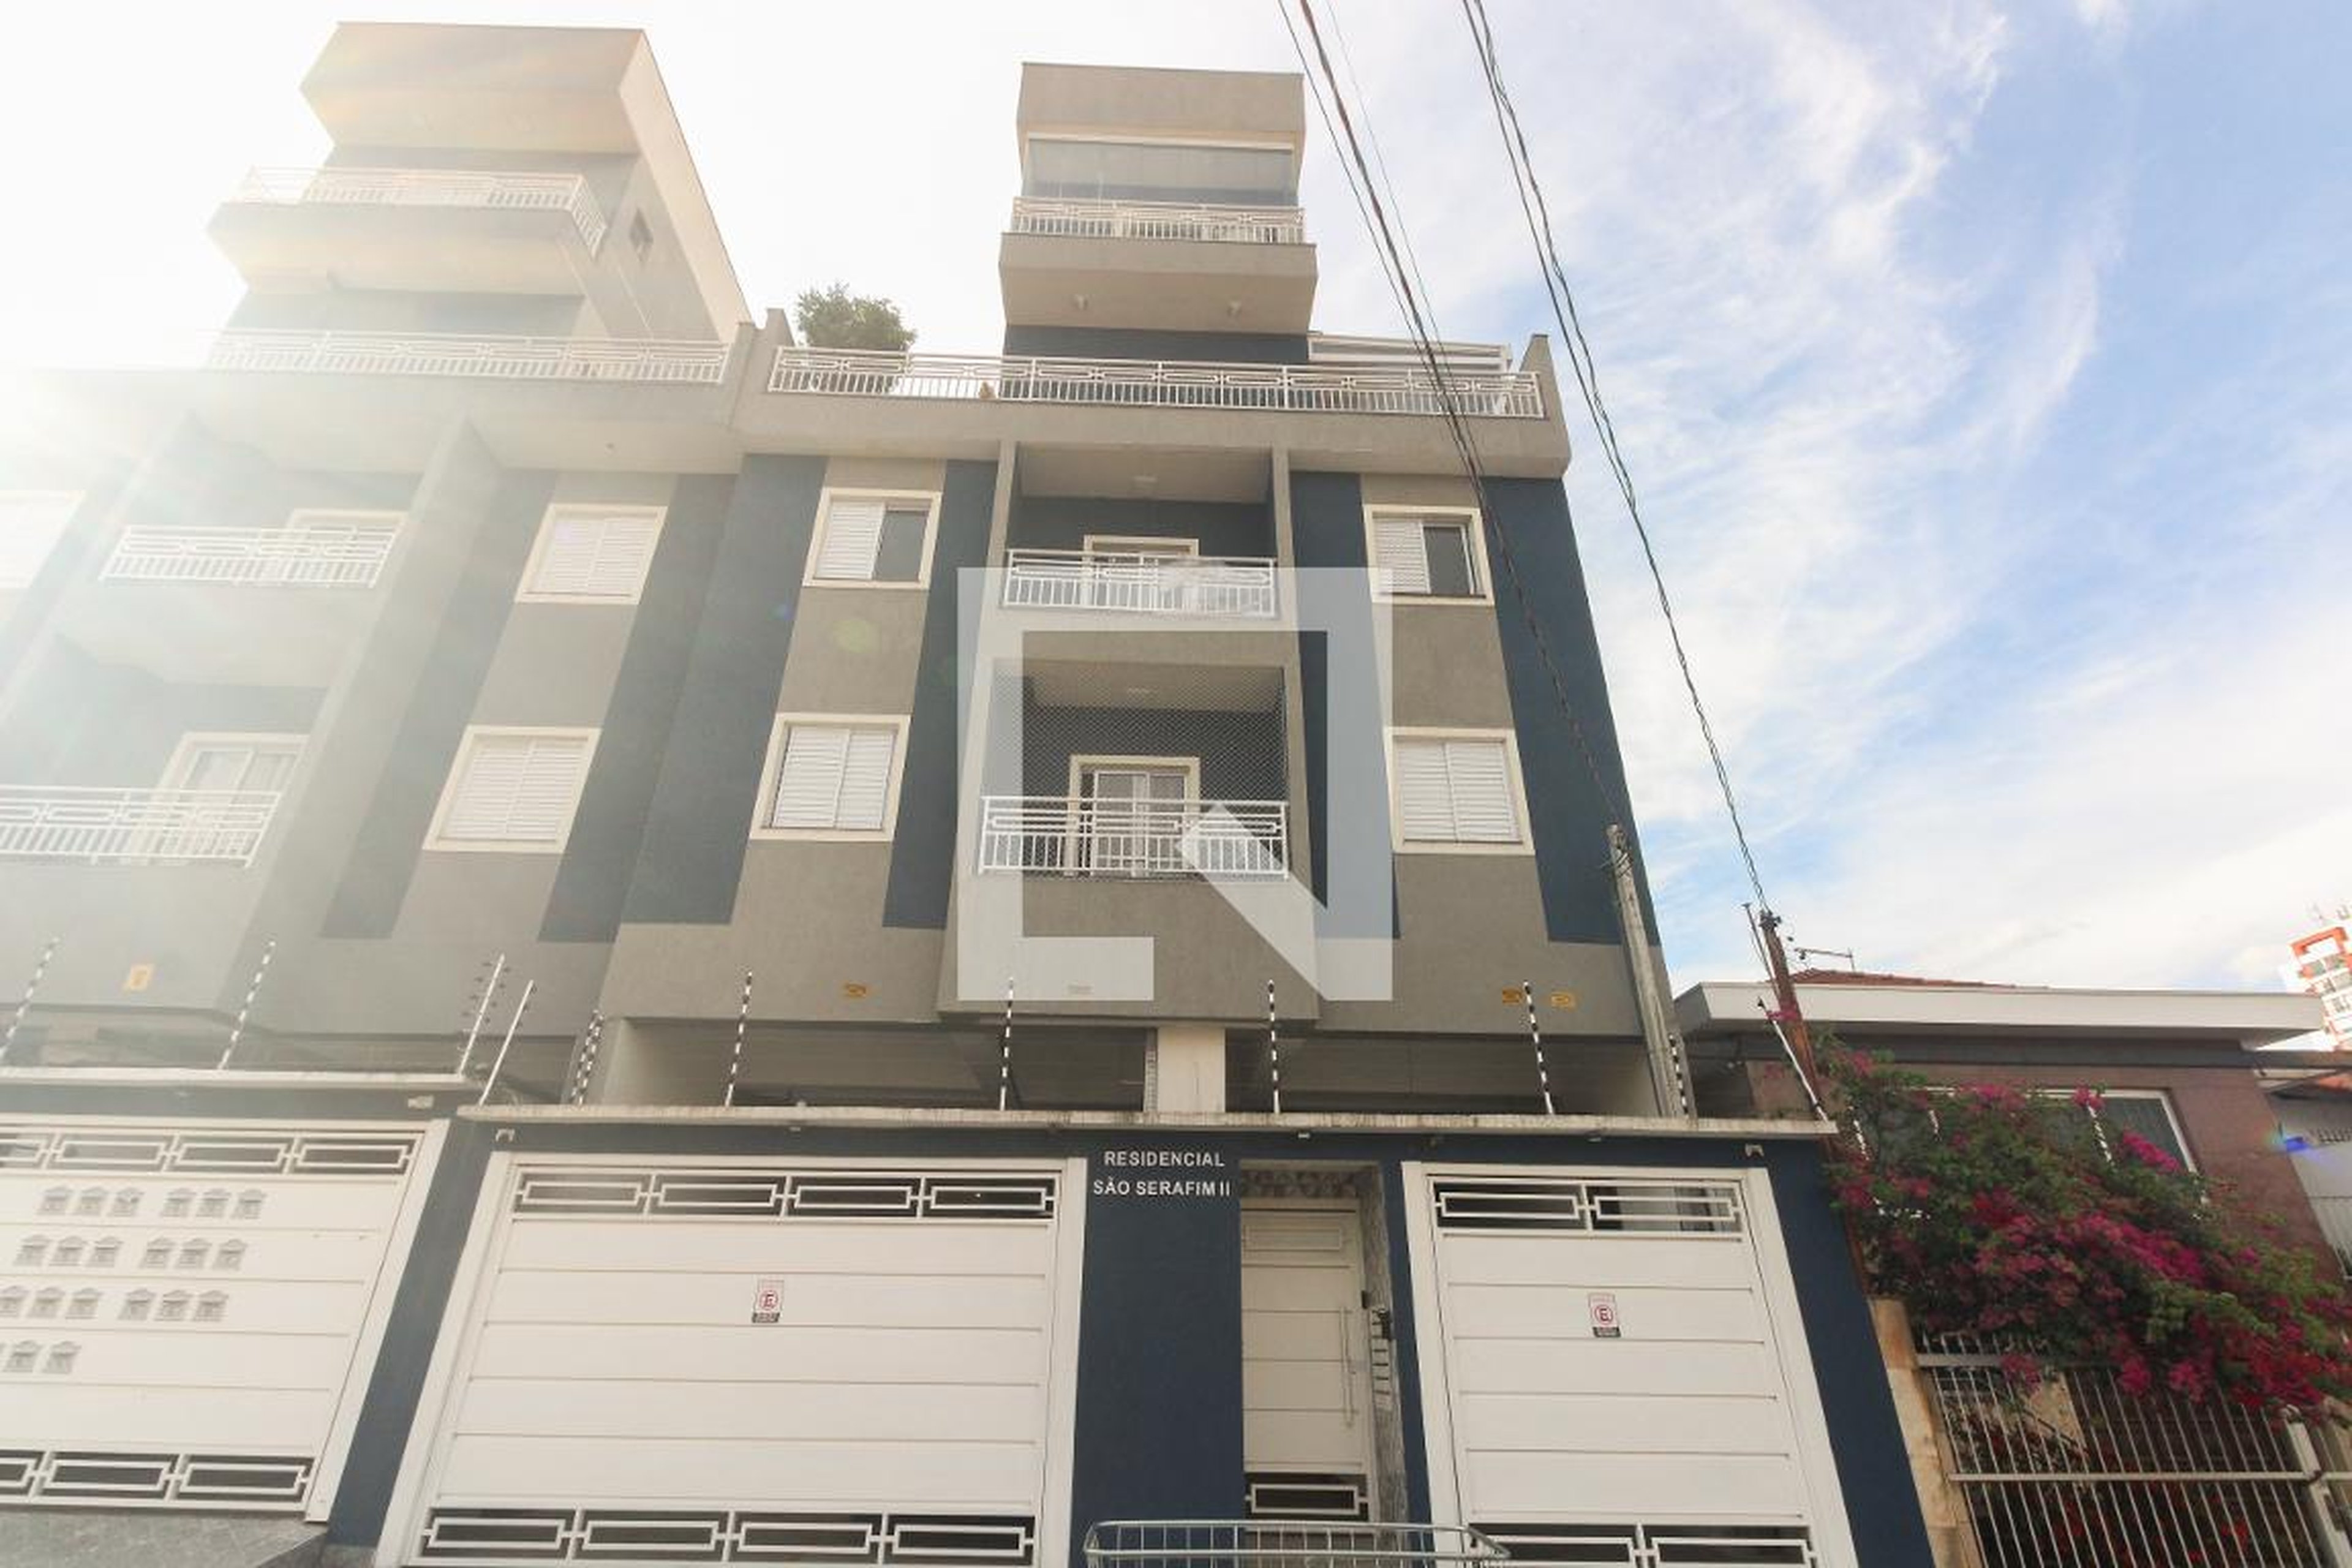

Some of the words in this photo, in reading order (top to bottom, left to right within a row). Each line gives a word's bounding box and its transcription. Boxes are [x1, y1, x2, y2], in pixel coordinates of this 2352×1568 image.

[1104, 1151, 1225, 1167] RESIDENCIAL
[1093, 1176, 1131, 1196] SÃO
[1136, 1180, 1215, 1196] SERAFIM
[1219, 1182, 1231, 1196] II
